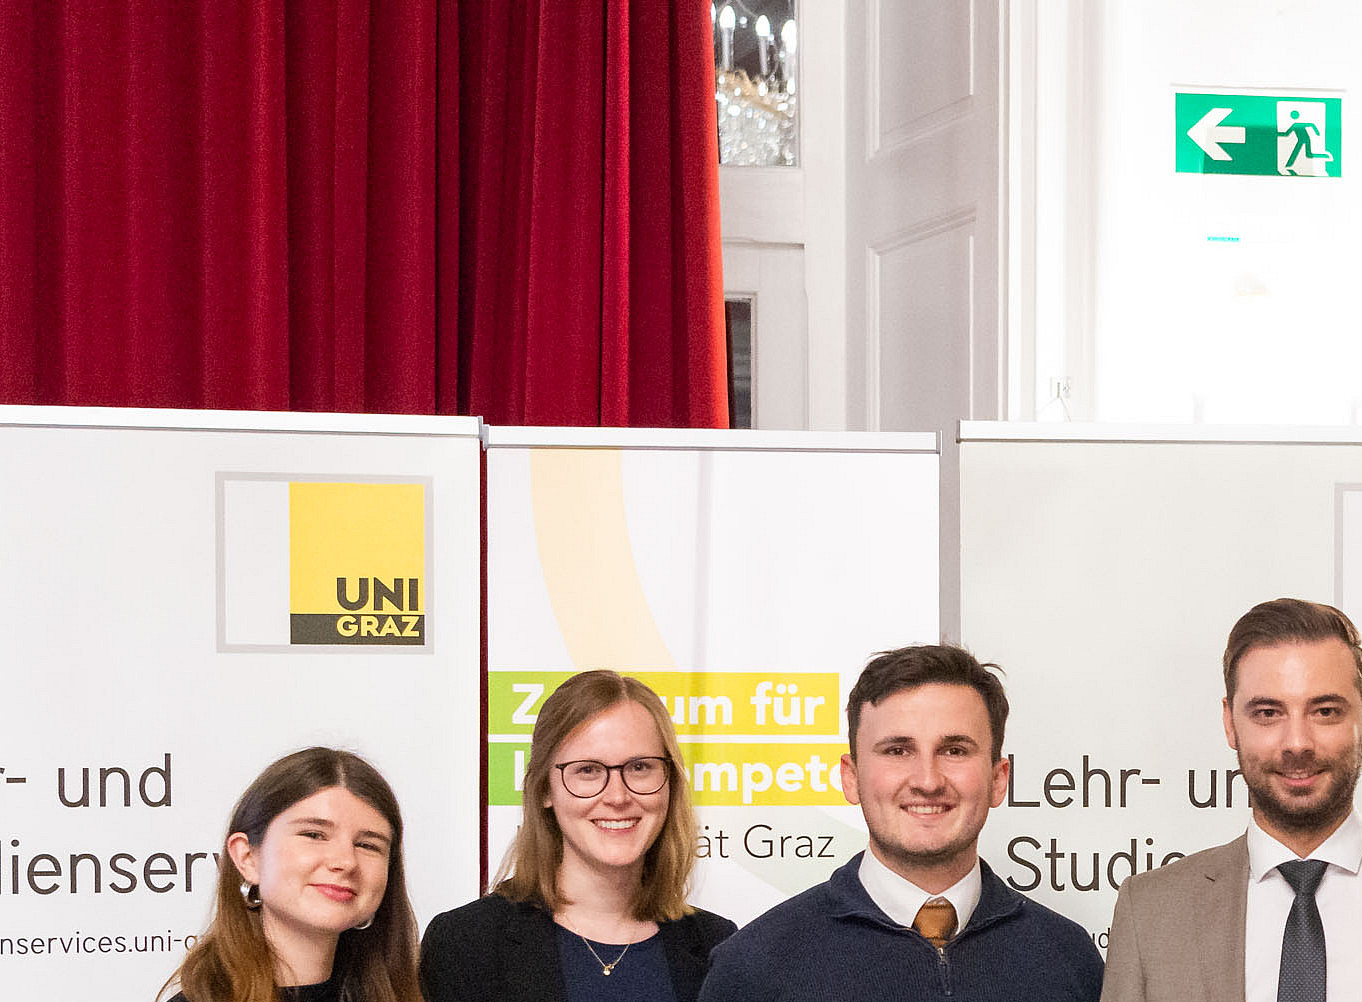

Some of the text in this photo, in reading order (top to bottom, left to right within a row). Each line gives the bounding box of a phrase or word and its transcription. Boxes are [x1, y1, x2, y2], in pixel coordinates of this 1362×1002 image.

[336, 577, 420, 612] UNI
[336, 614, 420, 638] GRAZ
[750, 681, 825, 726] für
[57, 752, 172, 808] und
[1007, 753, 1252, 809] Lehr- un
[743, 824, 835, 859] Graz
[0, 838, 222, 895] ienser
